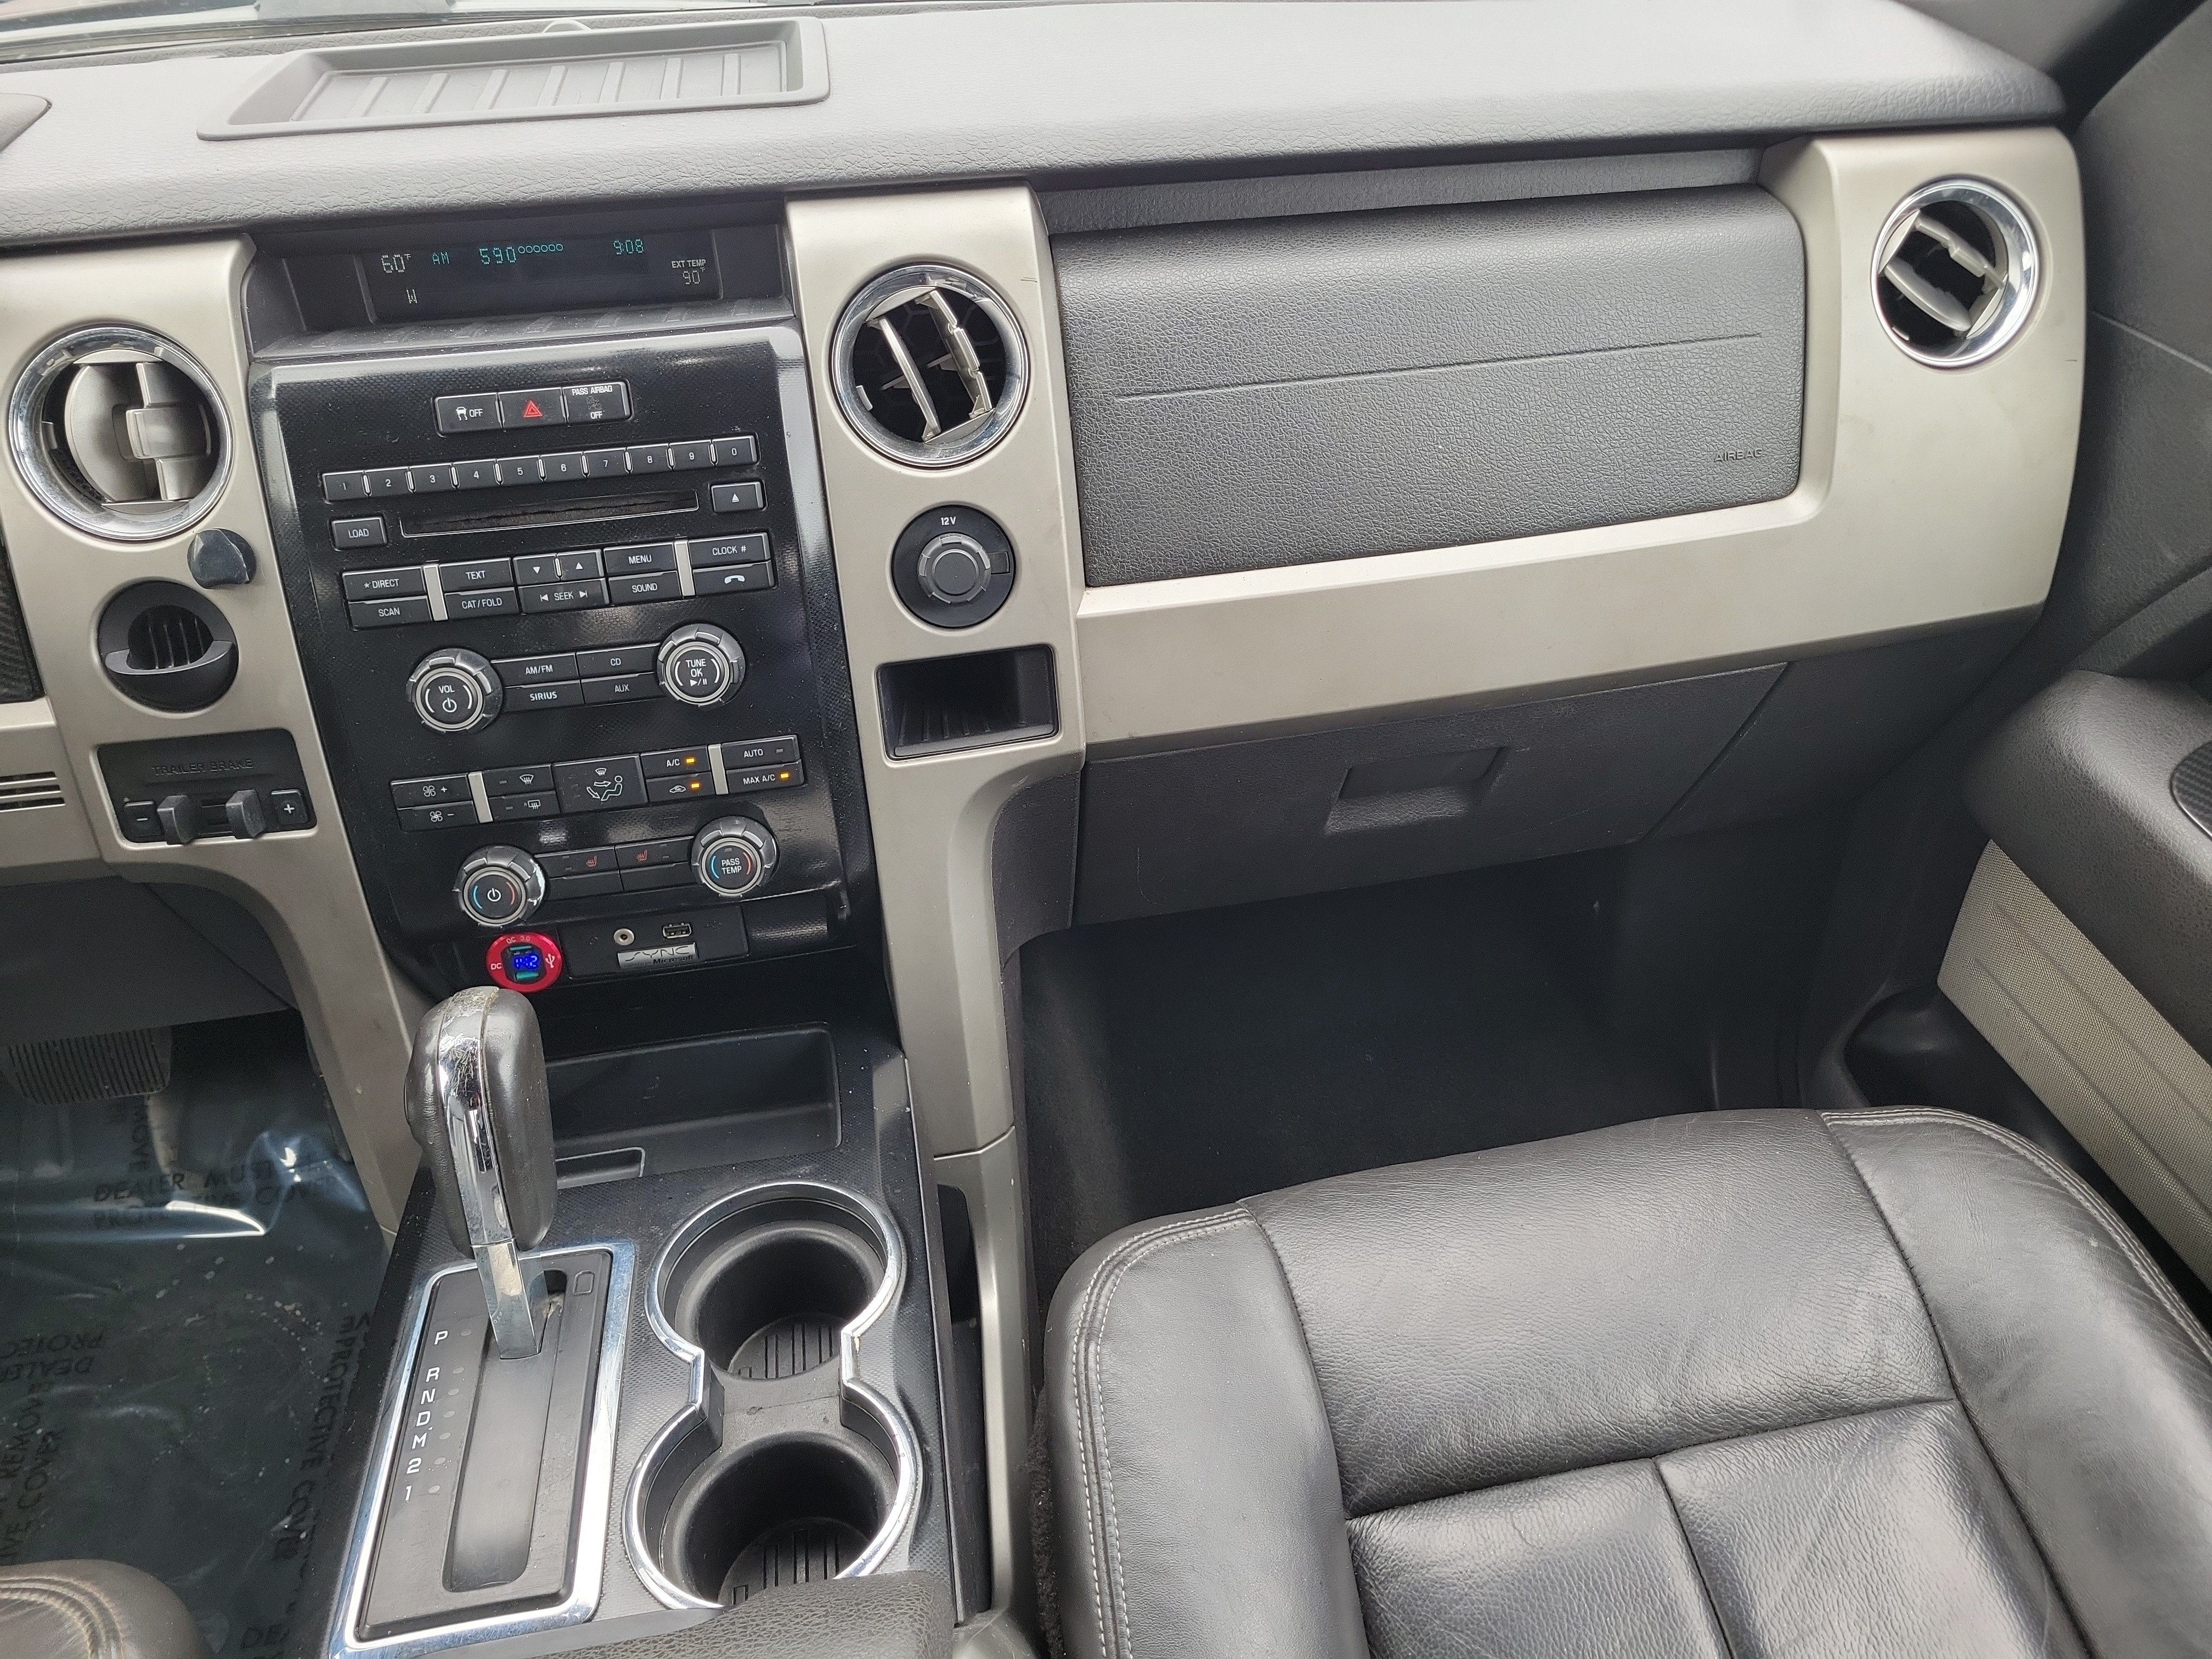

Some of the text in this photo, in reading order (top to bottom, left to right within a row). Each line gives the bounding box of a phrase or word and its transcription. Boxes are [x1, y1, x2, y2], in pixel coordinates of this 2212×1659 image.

[613, 239, 644, 255] 9:08
[431, 252, 450, 264] AM
[479, 247, 516, 264] 590
[672, 259, 706, 268] EXT TEMP
[406, 289, 417, 304] W
[571, 385, 613, 396] PASS AIRBAG
[469, 408, 483, 417] OFF
[590, 411, 602, 419] OFF
[1714, 448, 1763, 462] AIRBAG
[342, 482, 346, 490] 1
[385, 478, 392, 487] 2
[430, 475, 436, 483] 3
[473, 471, 479, 479] 4
[517, 467, 523, 476] 5
[561, 464, 567, 472] 6
[647, 455, 653, 464] 8
[689, 452, 695, 460] 9
[731, 448, 737, 456] 0
[940, 516, 956, 526] 12V
[348, 528, 369, 538] LOAD
[712, 545, 737, 556] CLOCK
[628, 555, 652, 564] MENU
[466, 570, 486, 579] TEXT
[372, 578, 399, 589] DIRECT
[631, 583, 658, 593] SOUND
[554, 591, 574, 601] SEEK
[461, 597, 503, 609] CAT/FOLD
[378, 607, 400, 617] SCAN
[610, 658, 622, 666] CD
[685, 658, 707, 668] TUNE
[526, 664, 553, 674] AM/FM
[690, 668, 703, 678] OK
[438, 685, 455, 693] VOL
[614, 684, 629, 692] AUX
[529, 691, 557, 701] SIRIUS
[744, 748, 763, 758] AUTO
[152, 759, 253, 776] TRAILER BRAKE
[667, 759, 680, 767] A/C
[743, 776, 760, 785] MAX
[721, 857, 741, 866] PASS
[721, 865, 742, 875] TEMP
[625, 945, 690, 961] SYNC
[653, 955, 693, 964] Microsoft
[405, 1330, 448, 1501] P R N D M 2 1
